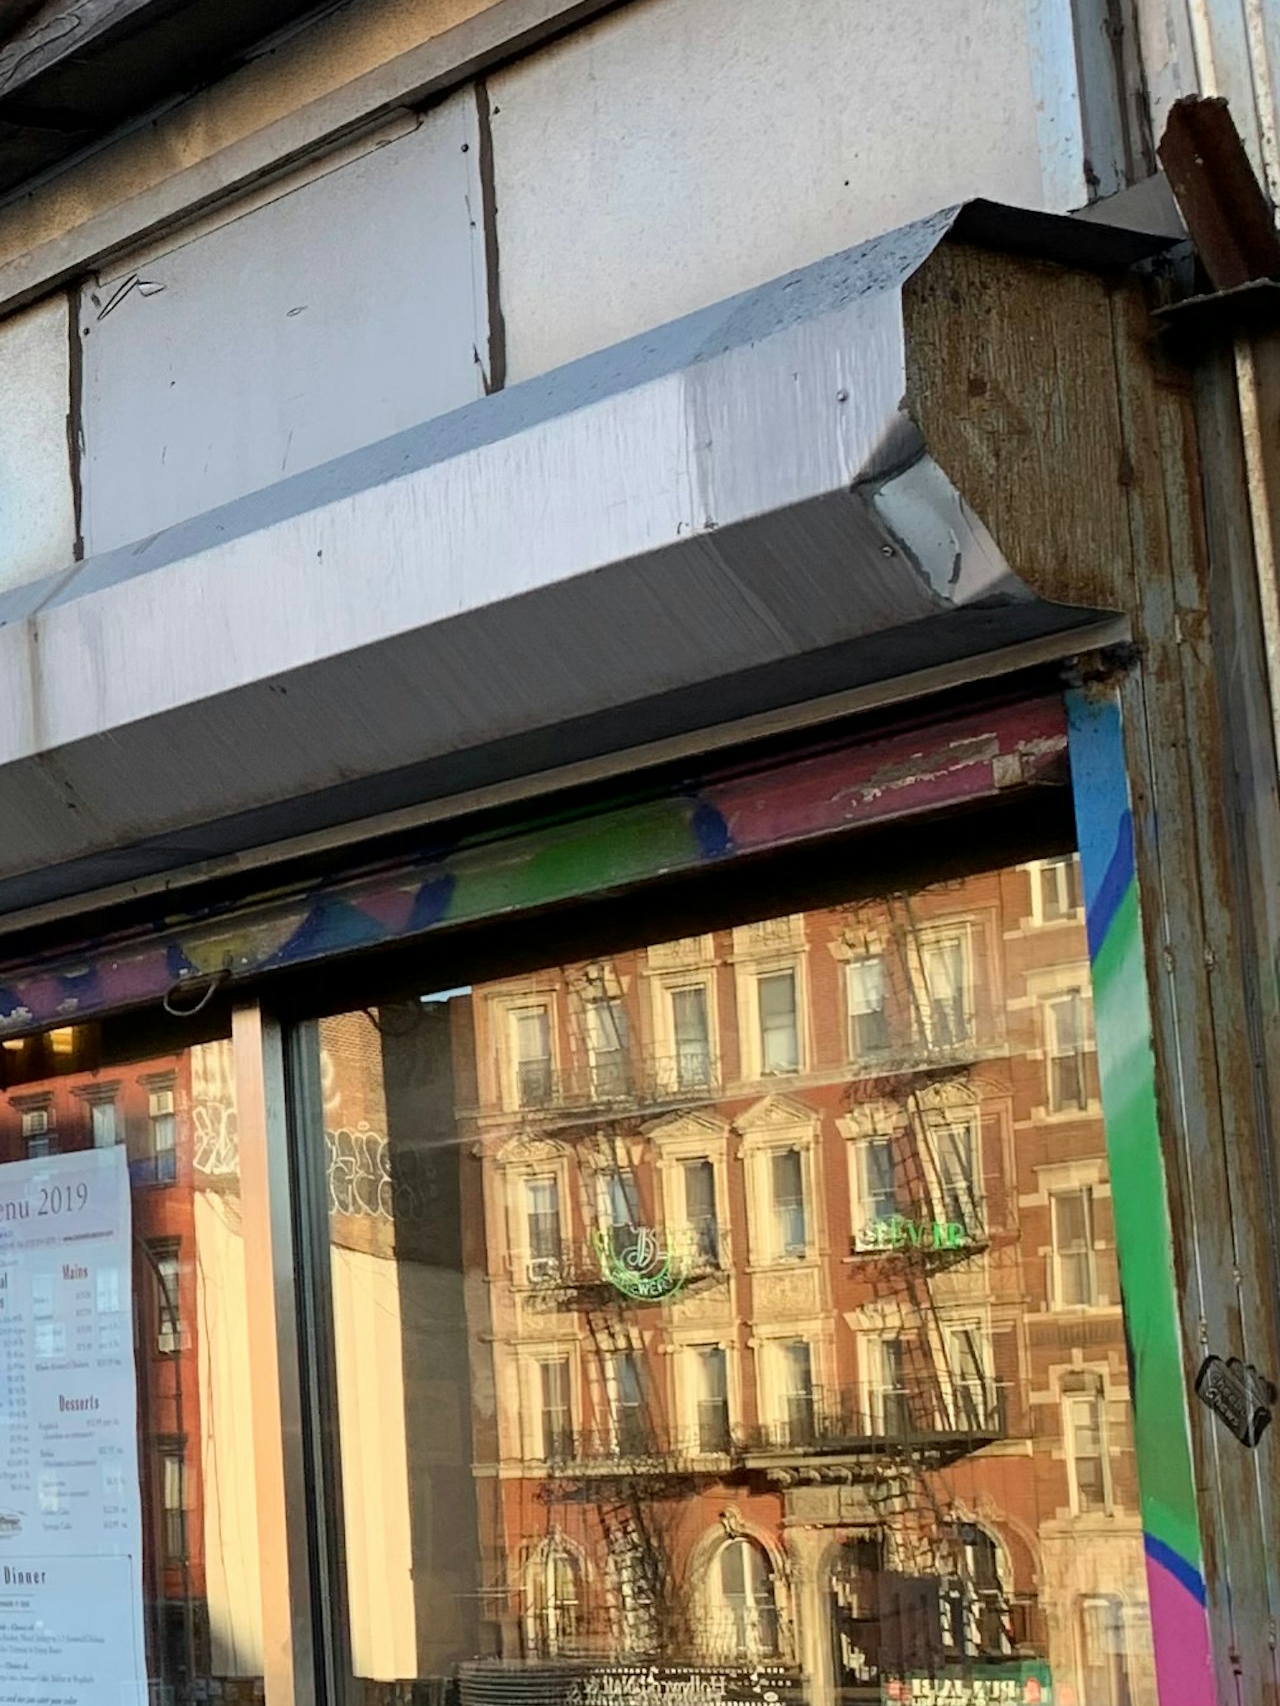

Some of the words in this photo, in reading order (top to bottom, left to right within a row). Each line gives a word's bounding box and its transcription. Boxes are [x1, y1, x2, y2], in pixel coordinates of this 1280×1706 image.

[37, 1182, 89, 1215] 2019
[59, 1394, 100, 1412] Desserts
[4, 1566, 46, 1585] Dinner
